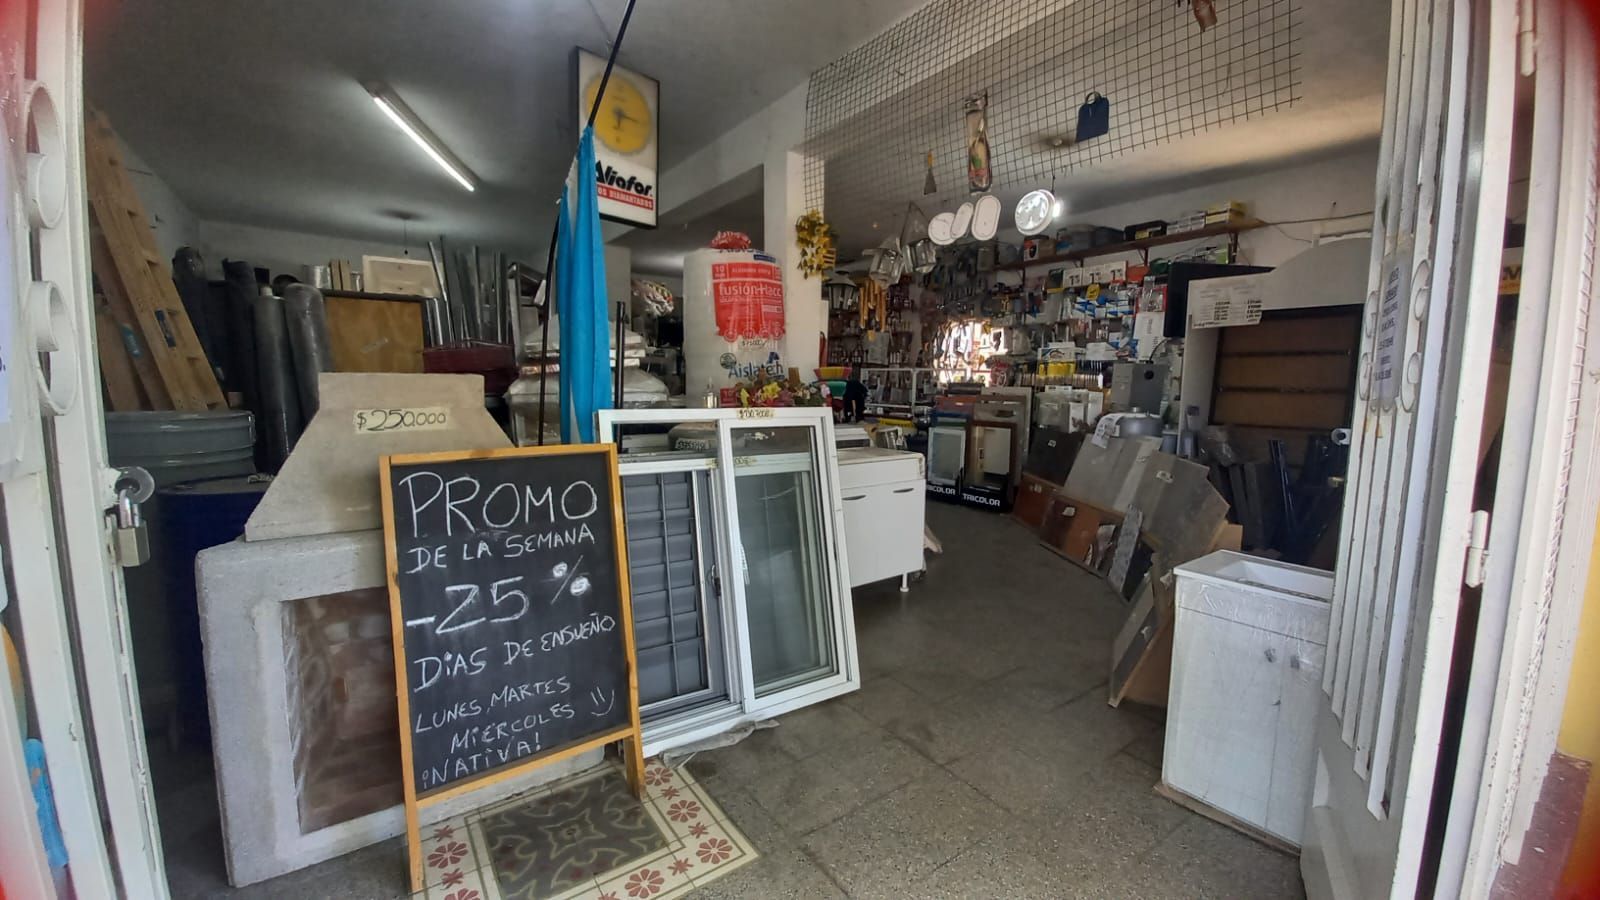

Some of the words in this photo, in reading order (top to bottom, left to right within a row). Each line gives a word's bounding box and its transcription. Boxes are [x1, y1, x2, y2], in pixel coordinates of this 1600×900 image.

[398, 471, 598, 539] PROMO
[962, 492, 1001, 507] TRICOLOR
[405, 545, 448, 574] DE
[462, 540, 492, 561] LA
[504, 523, 596, 558] SEMANA
[504, 640, 534, 666] DE
[541, 612, 616, 652] ENSUEÑO
[490, 676, 571, 708] MARTES
